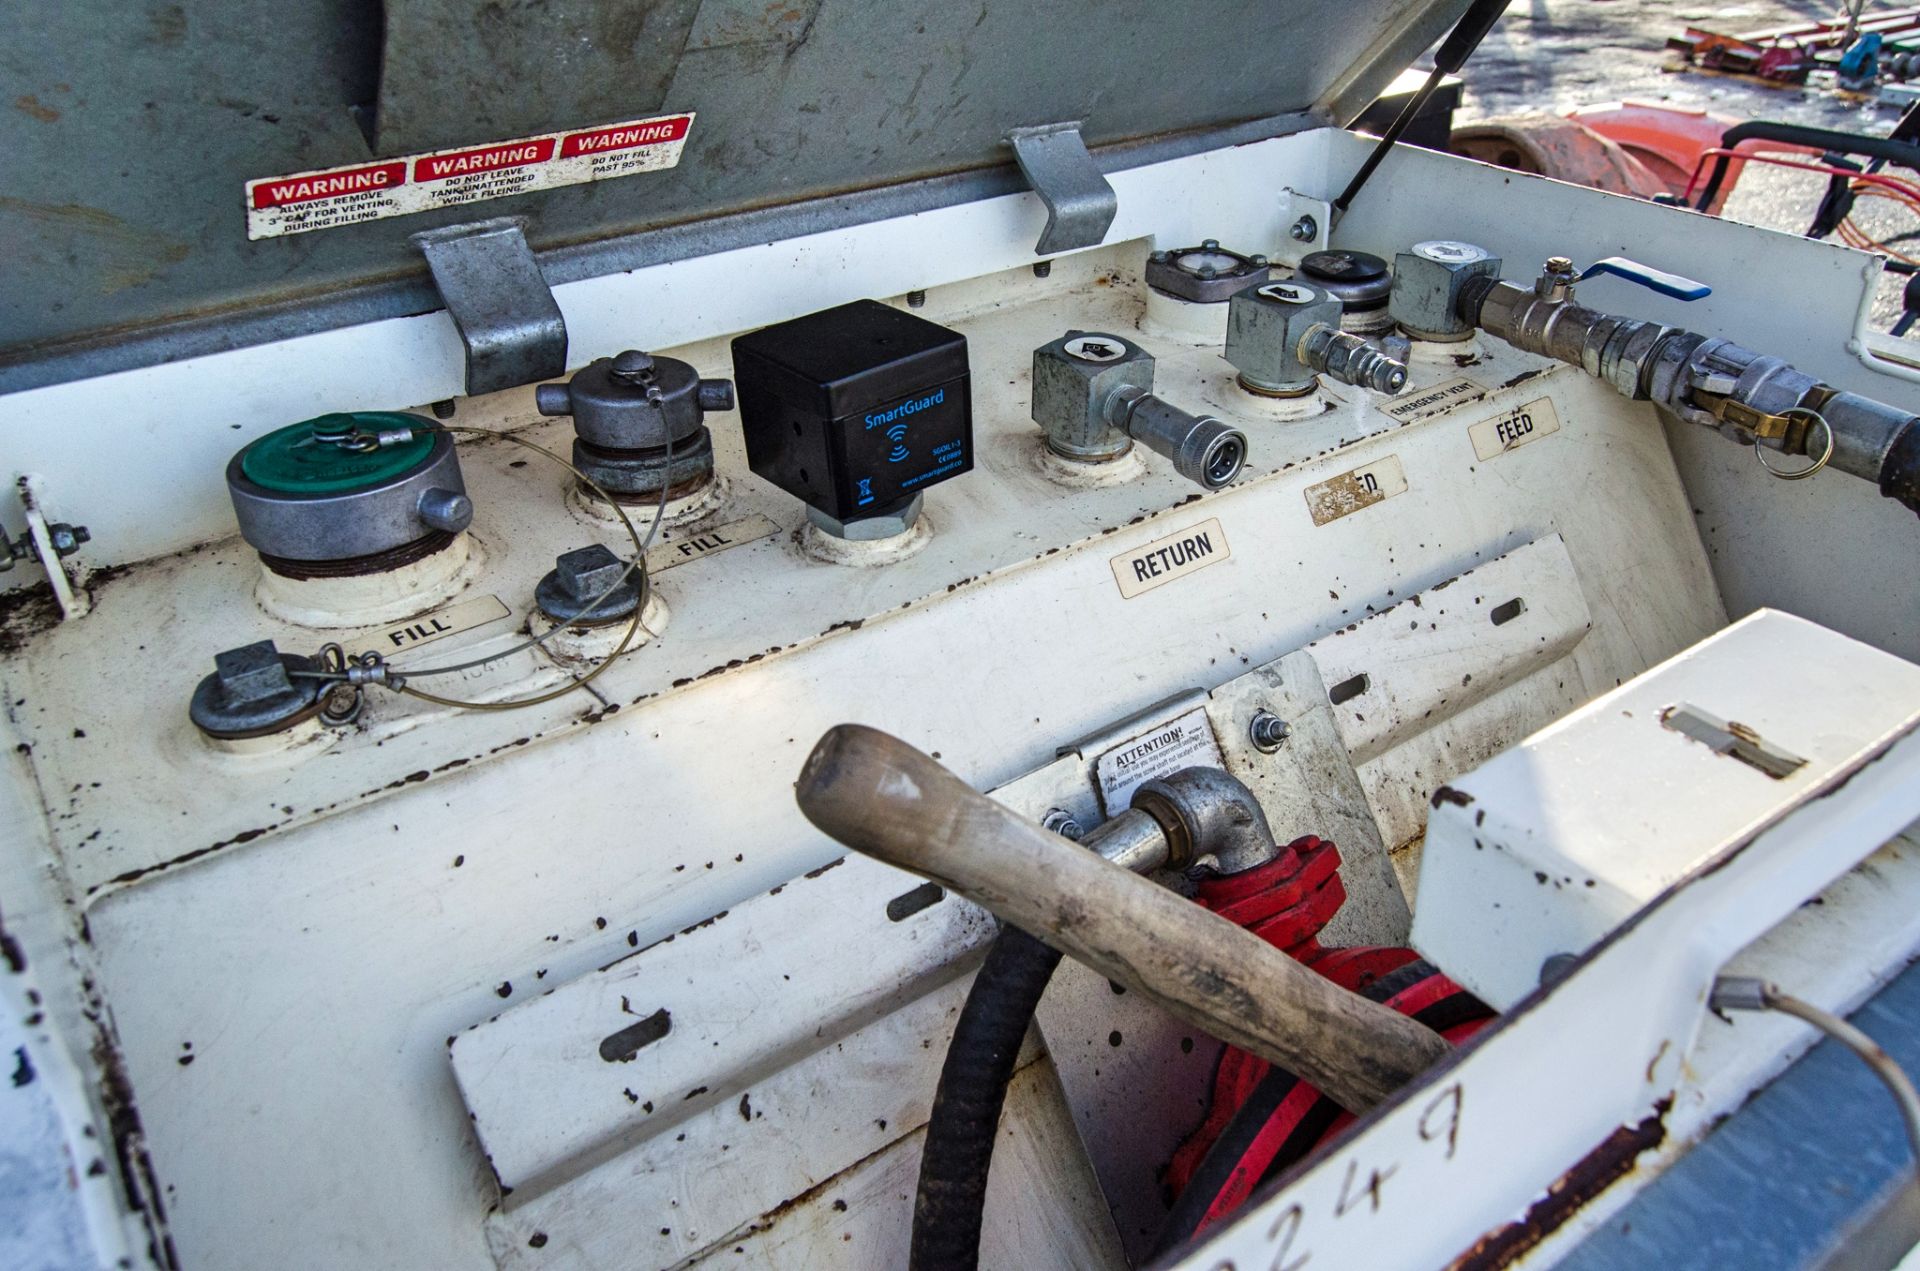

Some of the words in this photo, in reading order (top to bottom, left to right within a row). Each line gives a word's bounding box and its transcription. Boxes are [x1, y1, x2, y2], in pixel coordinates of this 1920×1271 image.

[578, 124, 675, 152] WARNING
[432, 146, 539, 175] WARNING
[591, 157, 607, 166] DO
[608, 153, 629, 163] NOT
[631, 150, 652, 160] FILL
[592, 163, 619, 174] PAST
[621, 159, 645, 169] 95%
[271, 169, 389, 201] WARNING
[431, 188, 460, 199] TANK
[462, 174, 536, 193] UNATTENDED
[445, 175, 461, 187] DO
[464, 172, 488, 184] NOT
[490, 167, 525, 180] LEAVE
[279, 199, 329, 214] ALWAYS
[333, 190, 384, 206] REMOVE
[314, 206, 338, 218] FOR
[442, 193, 477, 205] WHILE
[284, 218, 331, 232] DURING
[334, 210, 378, 224] FILLING
[865, 388, 944, 430] SmartGuard
[1390, 388, 1449, 418] EMERGENCY
[1446, 380, 1475, 400] VENT
[1495, 413, 1535, 443] FEED
[676, 533, 732, 557] FILL
[1132, 531, 1214, 583] RETURN
[387, 617, 452, 647] FILL
[1116, 726, 1184, 768] ATTENTION!
